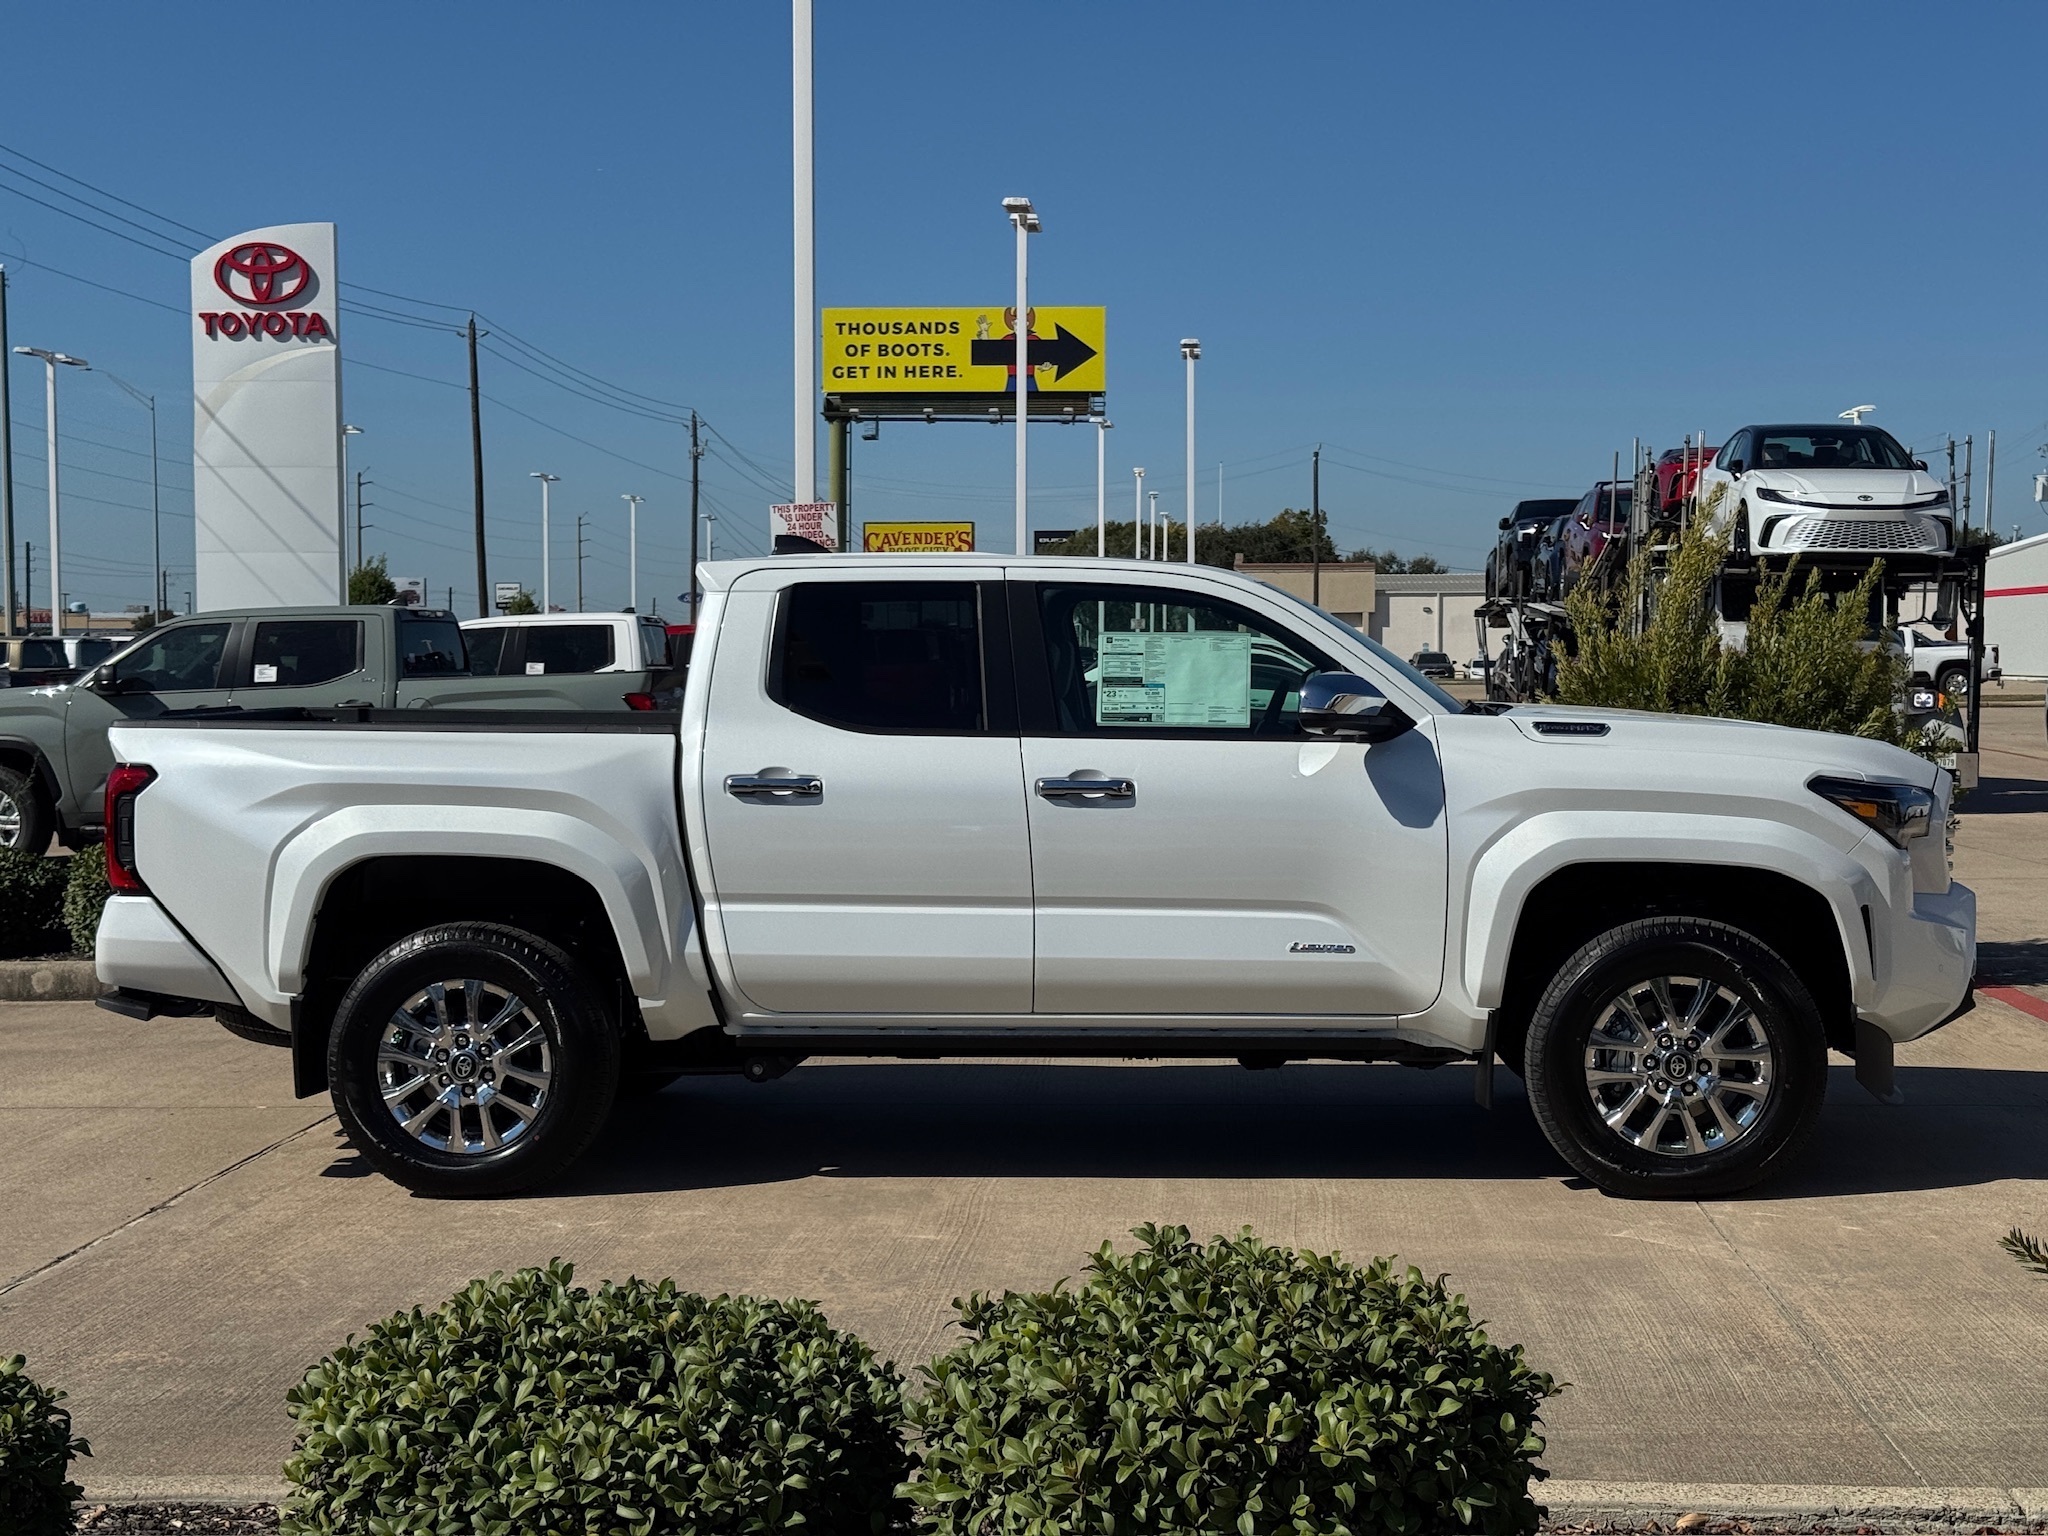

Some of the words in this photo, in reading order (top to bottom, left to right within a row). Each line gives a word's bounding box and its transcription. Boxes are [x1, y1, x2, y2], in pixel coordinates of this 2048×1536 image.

[199, 312, 327, 335] TOYOTA
[835, 321, 960, 335] THOUSANDS
[845, 344, 871, 357] OF
[877, 343, 950, 357] BOOTS.
[832, 366, 870, 379] GET
[877, 366, 897, 378] IN
[904, 365, 963, 378] HERE.
[772, 505, 791, 514] THIS
[793, 503, 835, 513] PROPERTY
[785, 513, 793, 522] IS
[795, 512, 823, 522] UNDER
[787, 523, 797, 531] 24
[798, 522, 822, 531] HOUR
[798, 530, 824, 539] VIDEO
[865, 530, 972, 552] CAVENDER'S
[1107, 690, 1117, 698] 23
